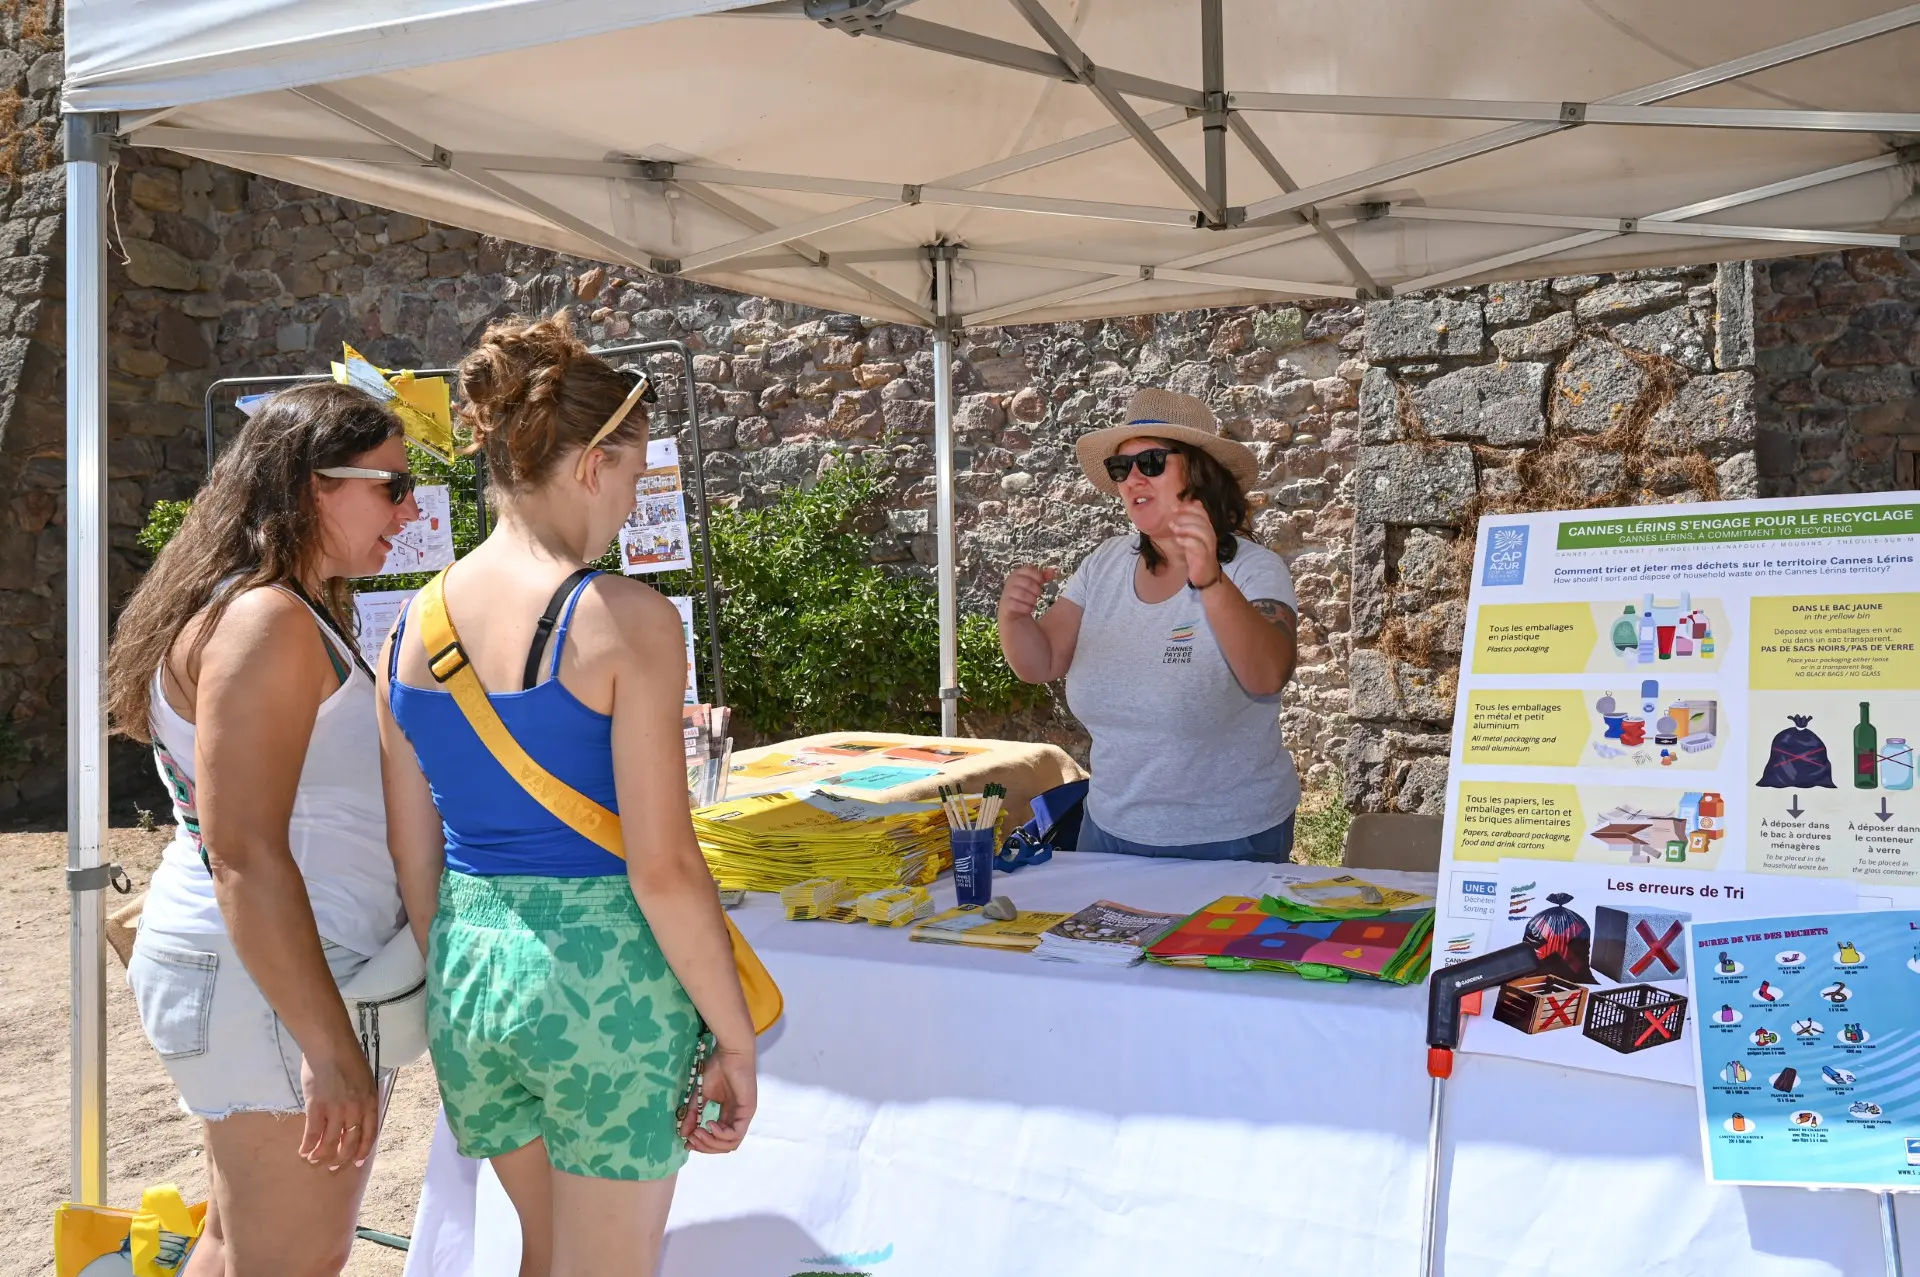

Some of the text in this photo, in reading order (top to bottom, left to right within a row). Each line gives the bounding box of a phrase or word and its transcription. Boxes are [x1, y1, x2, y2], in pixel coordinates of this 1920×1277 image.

[1569, 525, 1622, 537] CANNES
[1627, 520, 1676, 533] LÉRINS
[1755, 516, 1796, 527] POUR
[1801, 514, 1818, 524] LE
[1823, 510, 1913, 523] RECYCLAGE
[1619, 535, 1656, 544] CANNES
[1708, 528, 1775, 539] COMMITMENT
[1795, 525, 1852, 535] RECYCLING
[1491, 552, 1522, 563] CAP
[1489, 562, 1520, 571] AZUR
[1554, 567, 1602, 576] Comment
[1605, 566, 1627, 574] trier
[1643, 564, 1668, 574] jeter
[1696, 559, 1738, 570] déchets
[1764, 559, 1773, 567] le
[1777, 557, 1827, 566] territoire
[1830, 555, 1873, 565] Cannes
[1877, 554, 1913, 563] Lérins
[1573, 575, 1598, 583] should
[1640, 573, 1670, 582] dispose
[1684, 570, 1726, 579] household
[1785, 567, 1817, 575] Cannes
[1820, 566, 1846, 574] Lérins
[1849, 565, 1890, 574] territory?
[1526, 624, 1574, 632] emballages
[1501, 633, 1540, 641] plastique
[1512, 704, 1561, 713] emballages
[1525, 714, 1544, 722] petit
[1467, 795, 1487, 803] Tous
[1504, 797, 1539, 806] papiers,
[1465, 806, 1515, 815] emballages
[1532, 808, 1560, 816] carton
[1479, 815, 1512, 825] briques
[1515, 816, 1570, 826] alimentaires
[1761, 818, 1768, 827] À
[1771, 820, 1805, 829] déposer
[1848, 821, 1894, 832] À déposer
[1492, 830, 1530, 838] cardboard
[1532, 831, 1571, 842] packaging,
[1461, 838, 1478, 847] food
[1771, 842, 1820, 851] ménagères
[1465, 884, 1485, 892] UNE
[1608, 879, 1743, 899] Les erreurs de Tri
[1464, 905, 1487, 914] Sorting
[1699, 928, 1828, 948] DUREE DE VIE DES DECHETS
